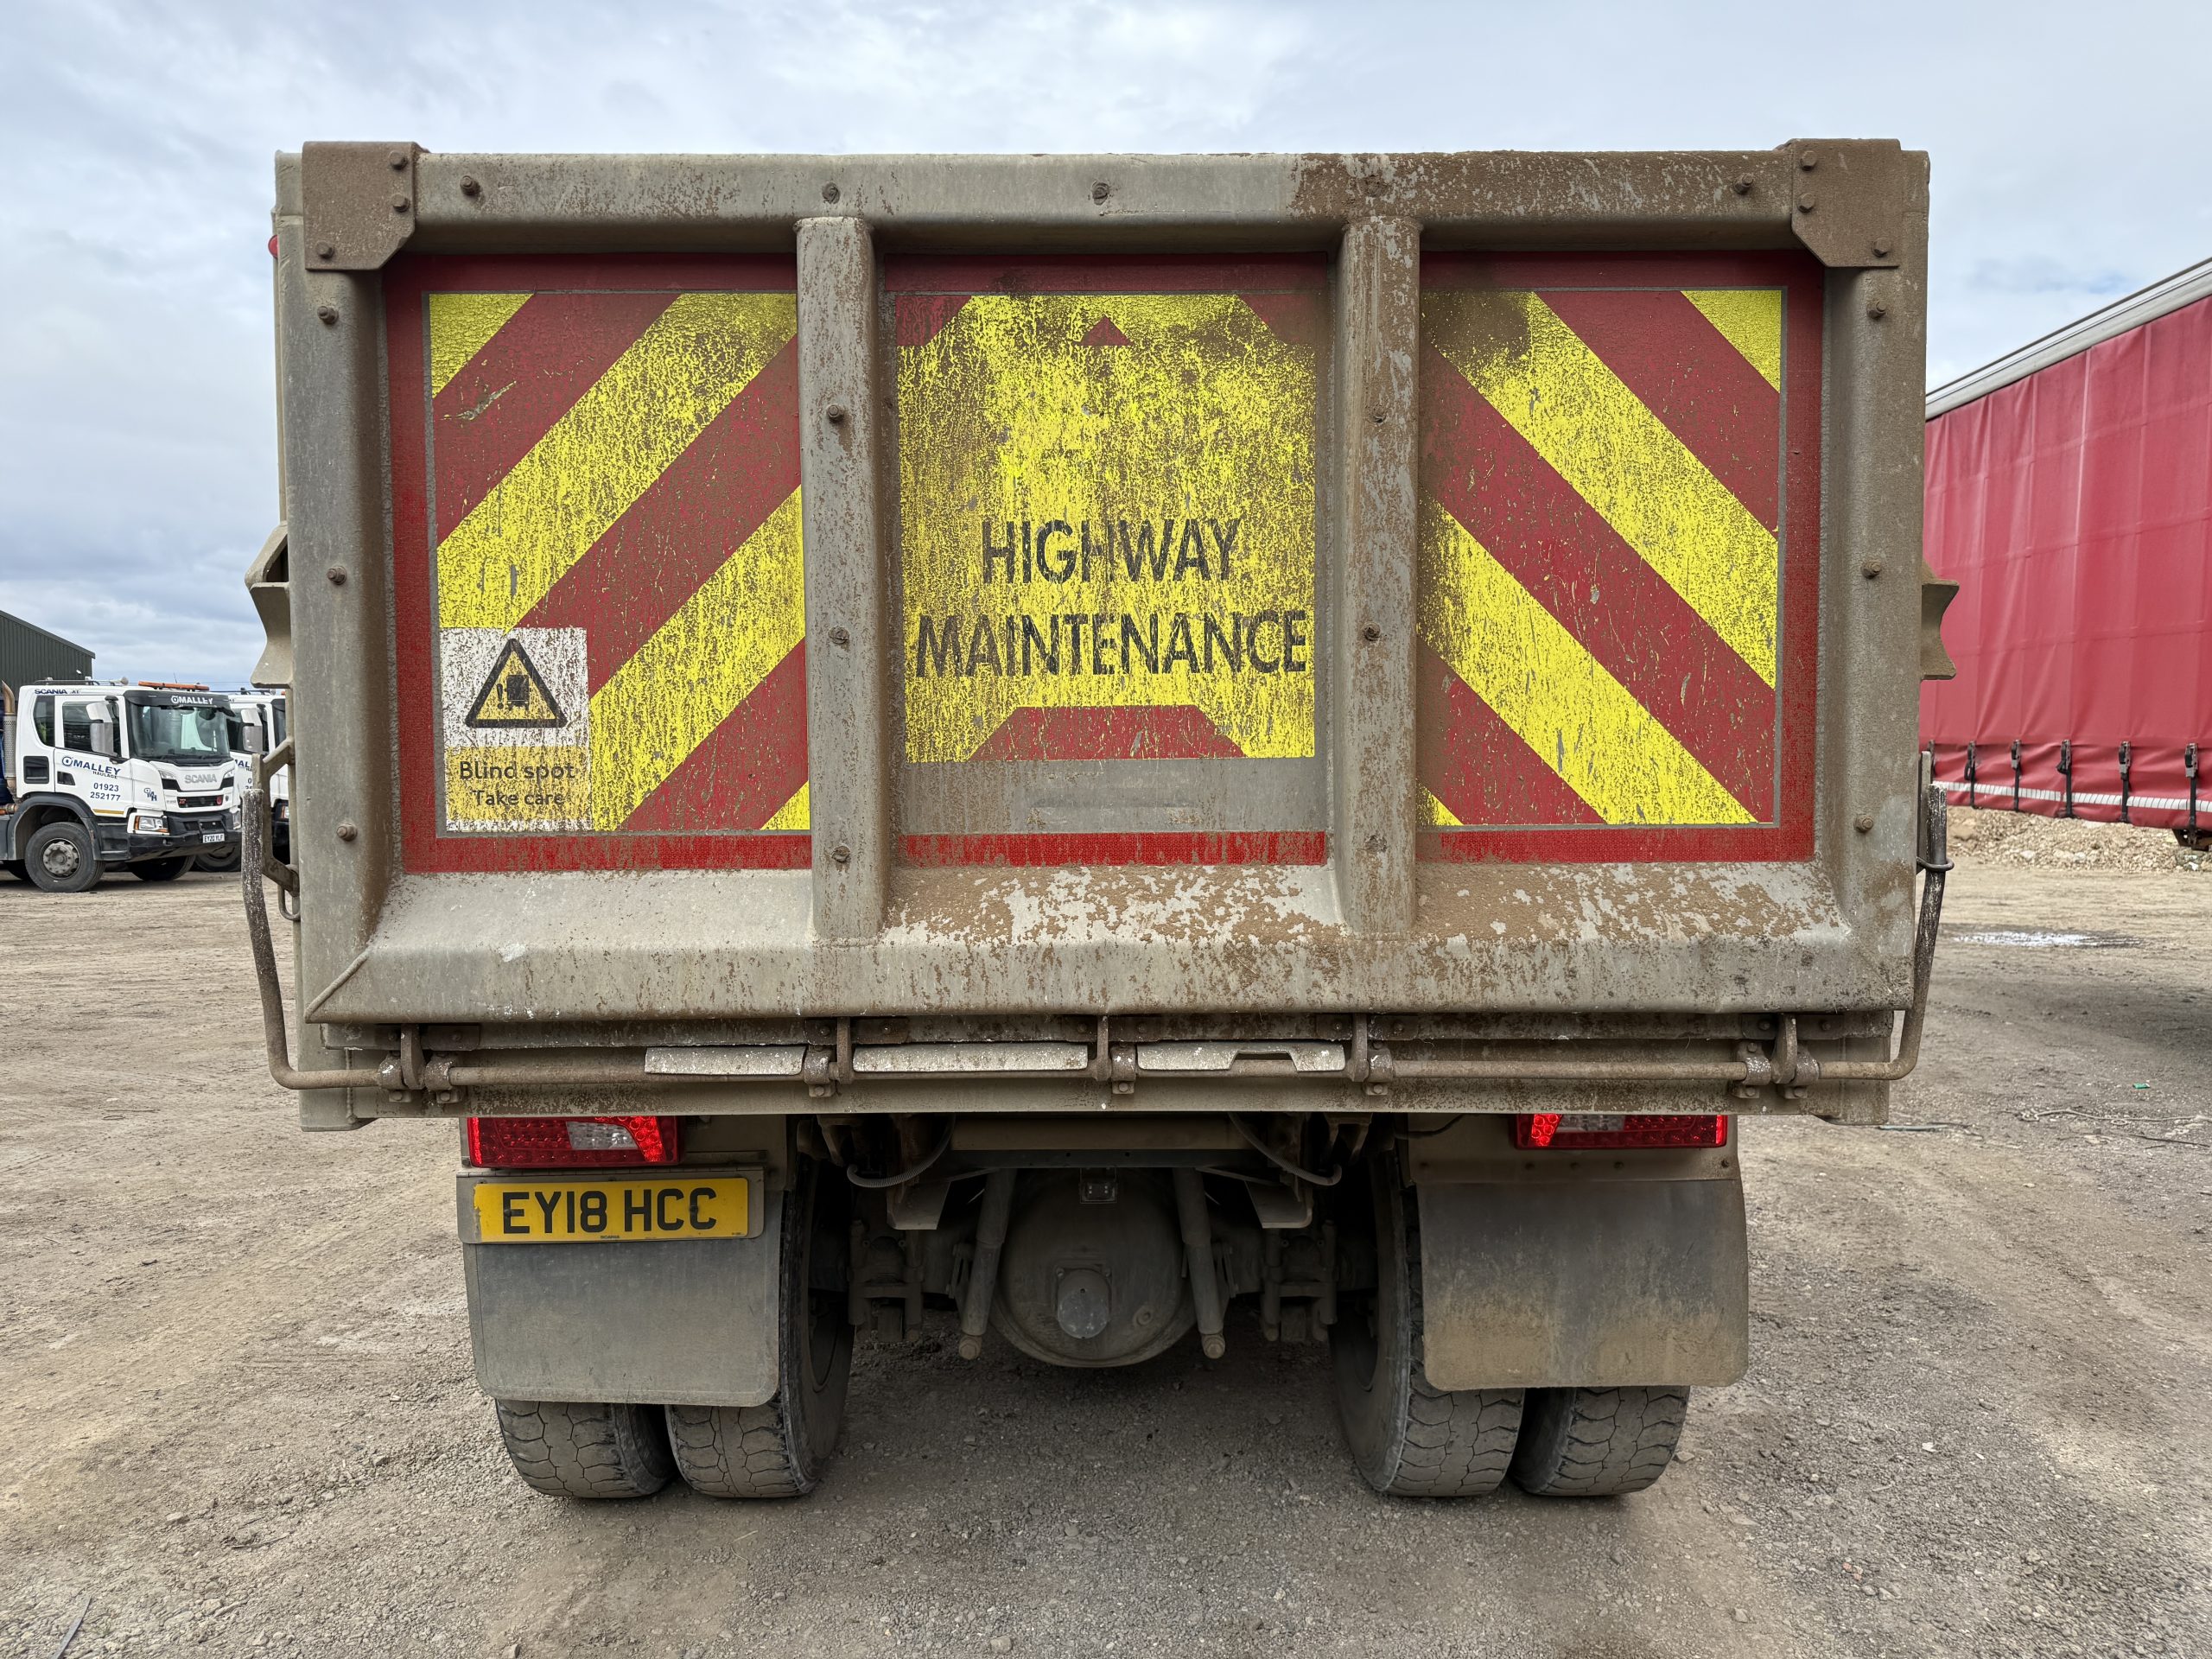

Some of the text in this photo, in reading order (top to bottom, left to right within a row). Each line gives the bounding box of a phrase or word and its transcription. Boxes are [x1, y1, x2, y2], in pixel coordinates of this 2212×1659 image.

[982, 518, 1242, 584] HIGHWAY
[917, 609, 1306, 678] MAINTENANCE
[92, 771, 118, 779] HAULAGE
[184, 774, 217, 784] SCANIA
[459, 760, 576, 787] Blind spot
[93, 782, 119, 792] 01923
[90, 791, 121, 801] 252177
[471, 790, 566, 806] Take care
[502, 1187, 717, 1234] EY18 HCC
